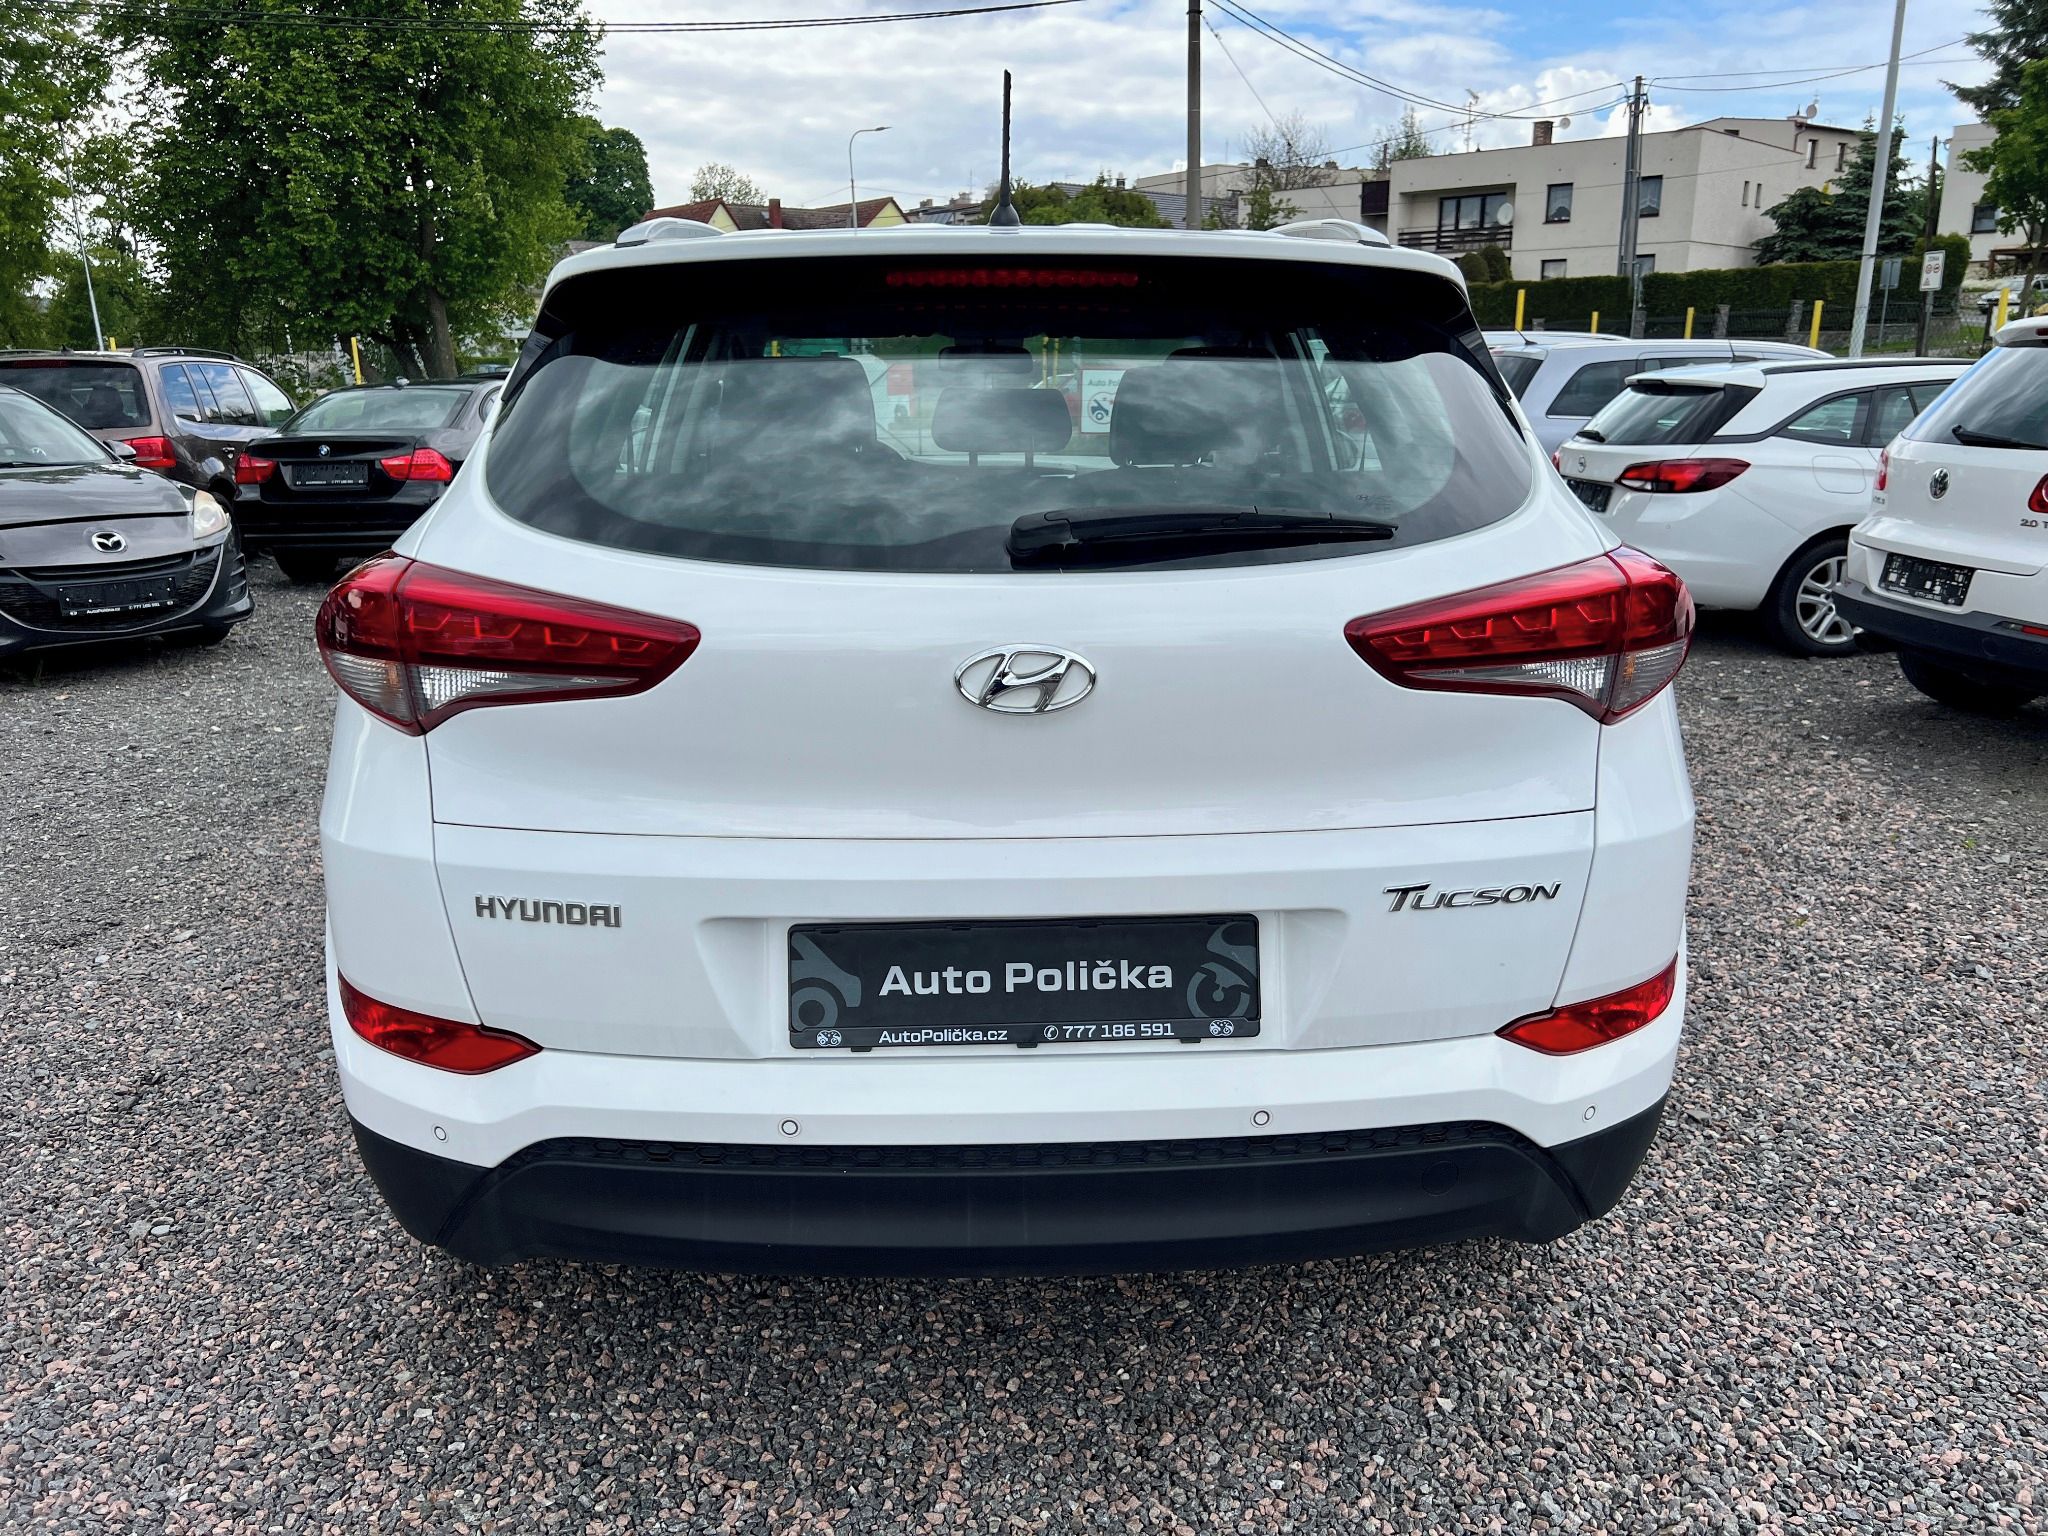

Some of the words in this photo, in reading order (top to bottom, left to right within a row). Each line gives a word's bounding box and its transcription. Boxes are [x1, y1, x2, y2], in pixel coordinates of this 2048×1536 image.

[474, 892, 622, 928] HYUNDAI
[879, 965, 992, 997] Auto
[1005, 959, 1173, 993] Polička
[878, 1027, 1008, 1045] AutoPolička.cz
[1063, 1024, 1097, 1039] 777
[1100, 1023, 1136, 1038] 186
[1140, 1022, 1175, 1037] 591
